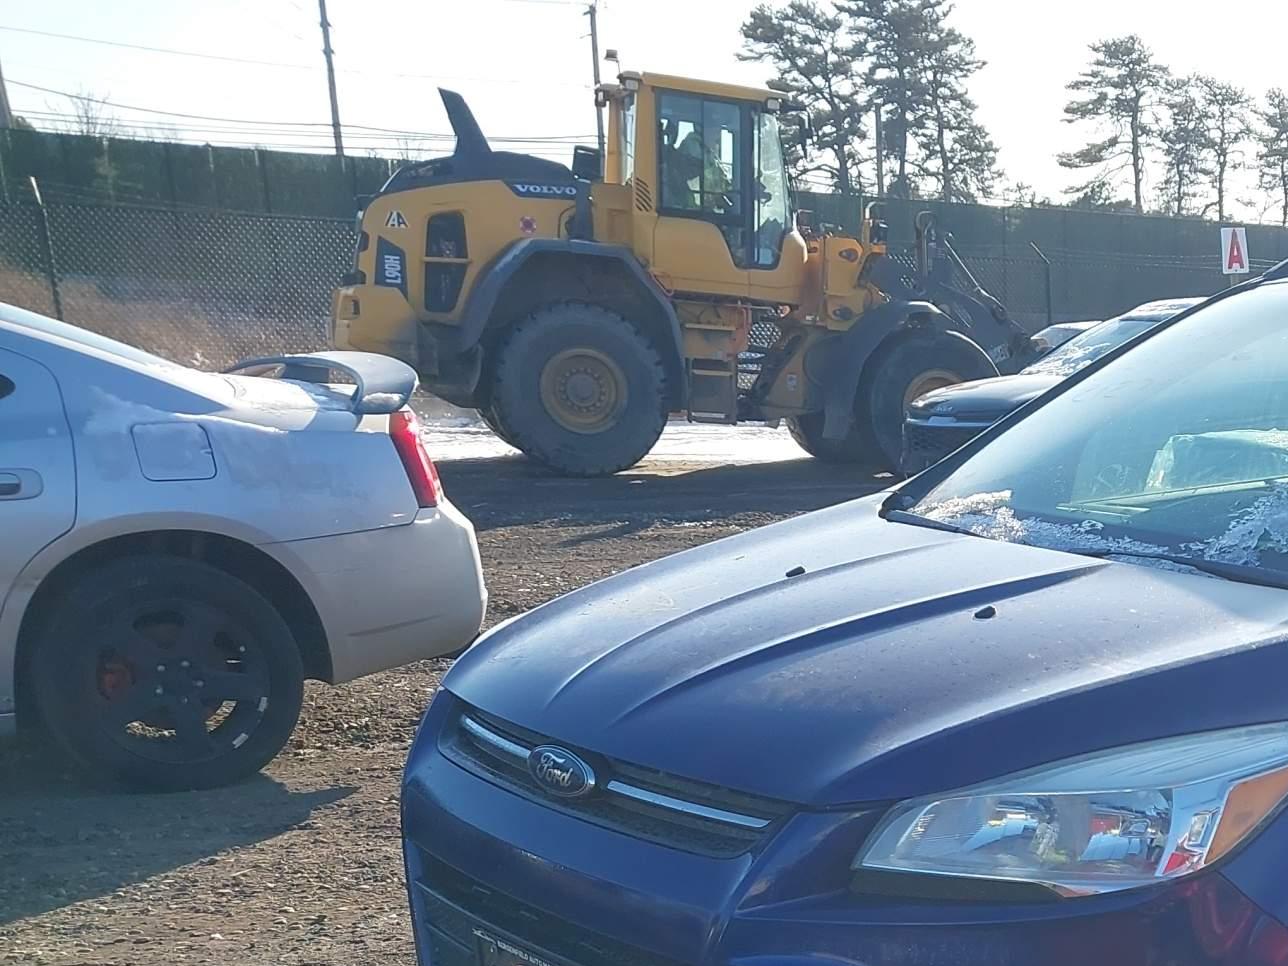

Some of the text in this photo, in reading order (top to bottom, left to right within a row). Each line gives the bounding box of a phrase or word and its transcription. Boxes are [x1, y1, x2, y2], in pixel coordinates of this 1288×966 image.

[513, 184, 577, 195] VOLVO
[1227, 228, 1245, 269] A
[384, 254, 401, 284] L90H
[536, 752, 574, 787] Ford
